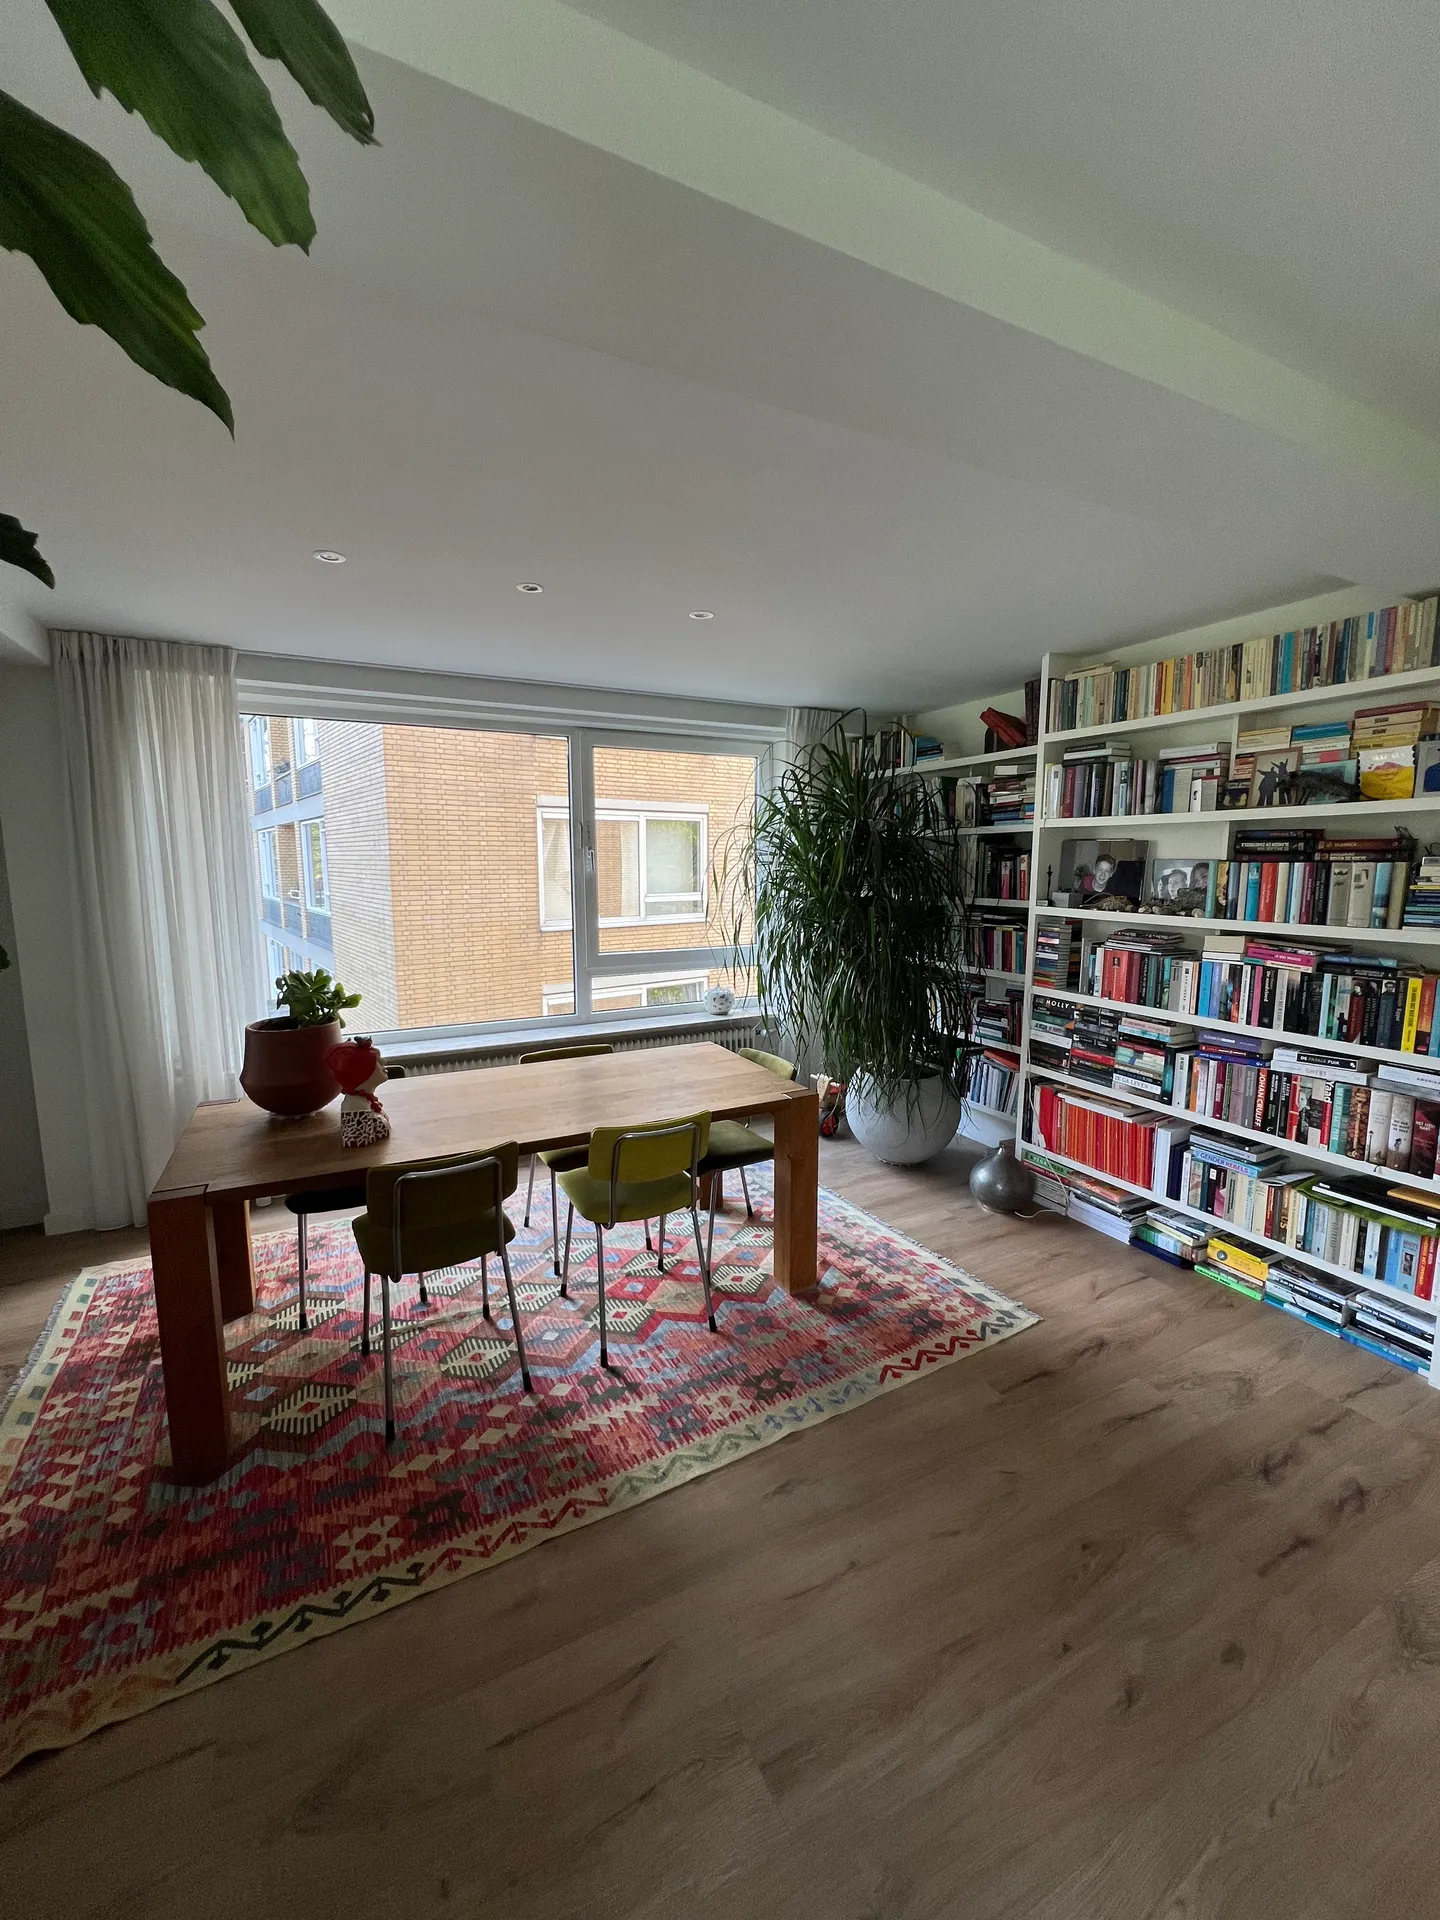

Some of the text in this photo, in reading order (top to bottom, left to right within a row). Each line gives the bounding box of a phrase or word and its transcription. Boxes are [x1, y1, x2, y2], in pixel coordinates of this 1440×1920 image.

[1046, 1000, 1070, 1009] HOLLY
[1130, 1078, 1148, 1089] LEVEN
[1324, 1080, 1334, 1104] Yaad
[1255, 1072, 1266, 1127] JOHAN CRUIJFF
[1200, 1152, 1248, 1174] GENDER REBELS
